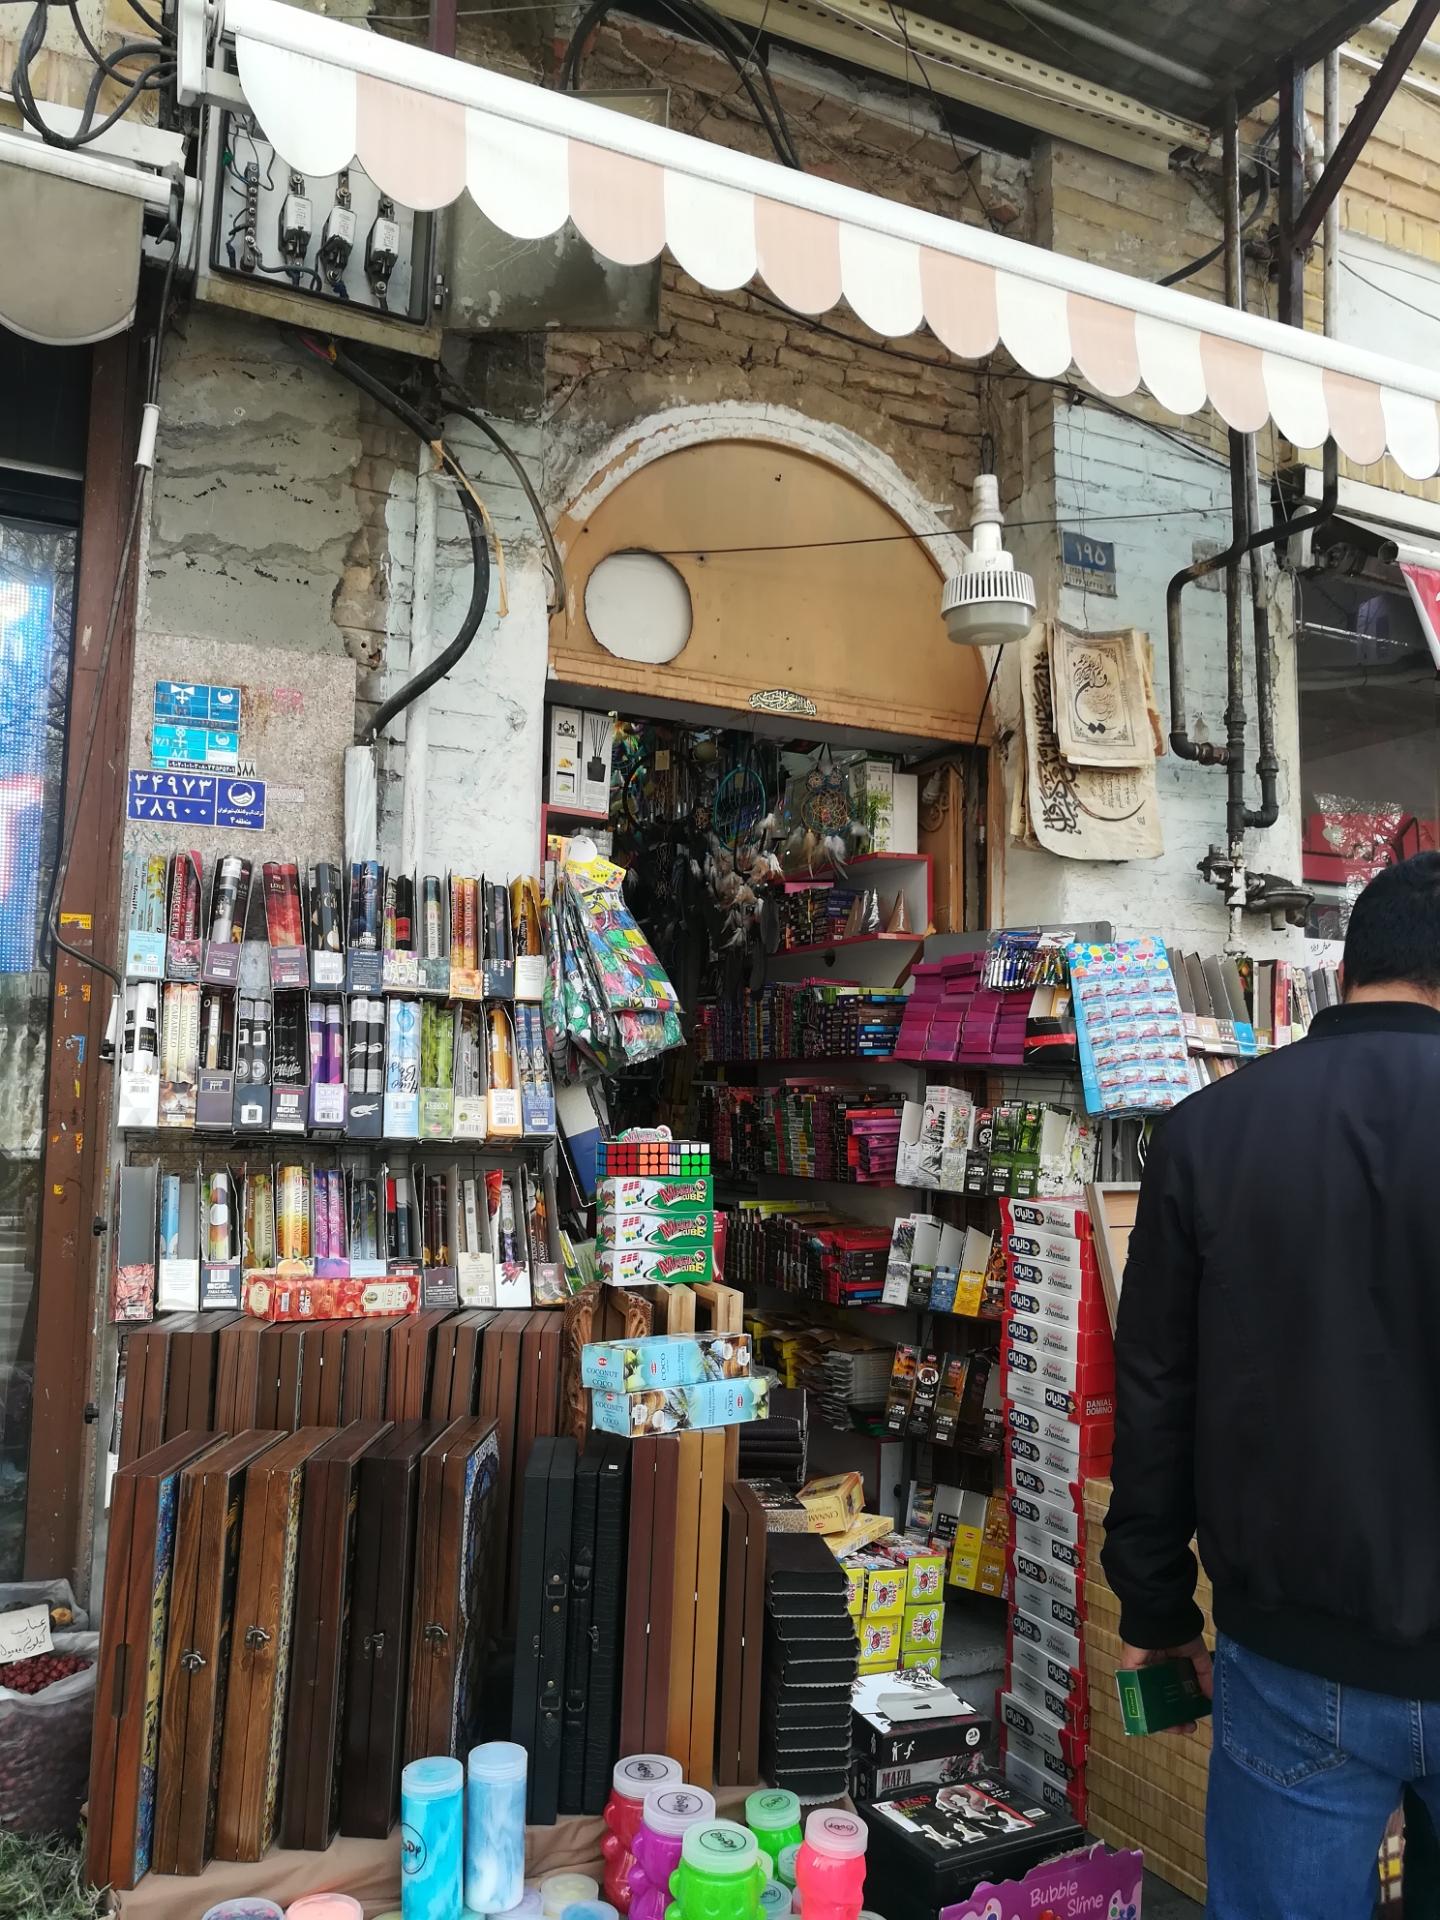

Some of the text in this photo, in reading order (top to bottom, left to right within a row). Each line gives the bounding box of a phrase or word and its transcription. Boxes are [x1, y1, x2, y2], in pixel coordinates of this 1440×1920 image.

[1075, 541, 1107, 566] ۱۹۵
[135, 773, 212, 797] ۳۴۹۷۳
[135, 798, 207, 819] ۲۸۹۰۰
[1046, 1216, 1071, 1228] Domino
[1046, 1250, 1071, 1262] Domino
[1048, 1277, 1073, 1290] Domino
[1045, 1308, 1070, 1321] Domino
[1043, 1338, 1069, 1352] Domino
[586, 1367, 619, 1379] COCONUT
[1042, 1368, 1068, 1383] Domino
[592, 1379, 614, 1388] COCO
[596, 1401, 624, 1413] COCONUT
[1086, 1399, 1112, 1409] DANIAL
[1086, 1406, 1113, 1416] DOMINO
[602, 1416, 620, 1426] COCO
[1044, 1428, 1070, 1444] Domino
[1045, 1457, 1070, 1474] Domino
[807, 1509, 840, 1524] CINNAM
[1044, 1516, 1069, 1533] Domino
[1048, 1575, 1073, 1595] Domino
[1046, 1638, 1071, 1659] Domino
[881, 1768, 912, 1790] MAFIA
[1029, 1880, 1078, 1908] Bubble
[1067, 1892, 1105, 1917] Slime
